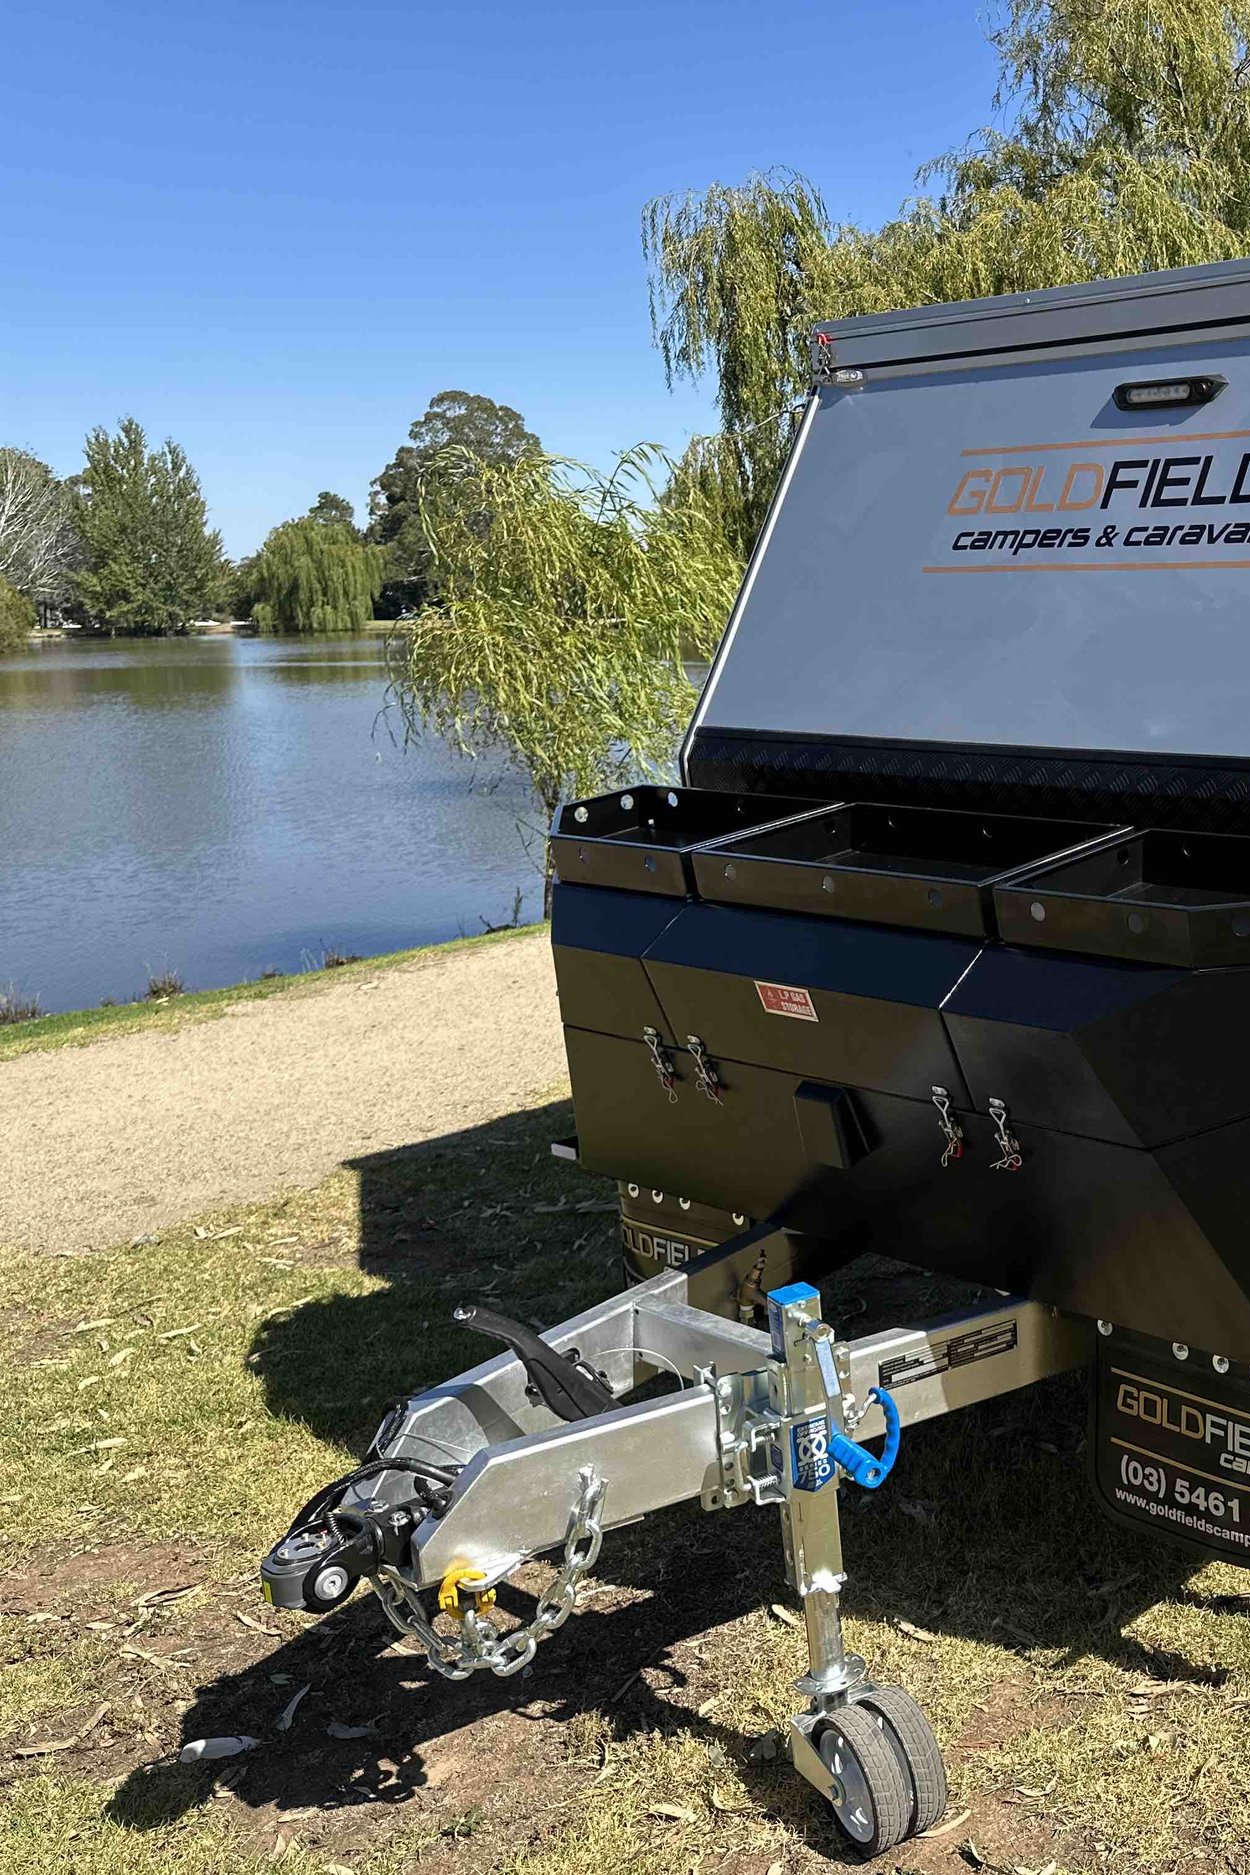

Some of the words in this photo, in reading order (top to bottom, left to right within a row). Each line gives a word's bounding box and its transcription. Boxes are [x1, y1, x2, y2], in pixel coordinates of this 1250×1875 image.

[952, 527, 1091, 555] campers
[1095, 524, 1120, 548] &
[781, 1001, 812, 1016] STORAGE
[799, 1464, 831, 1484] 750
[1120, 1454, 1166, 1498] (03)
[1174, 1478, 1240, 1522] 5461
